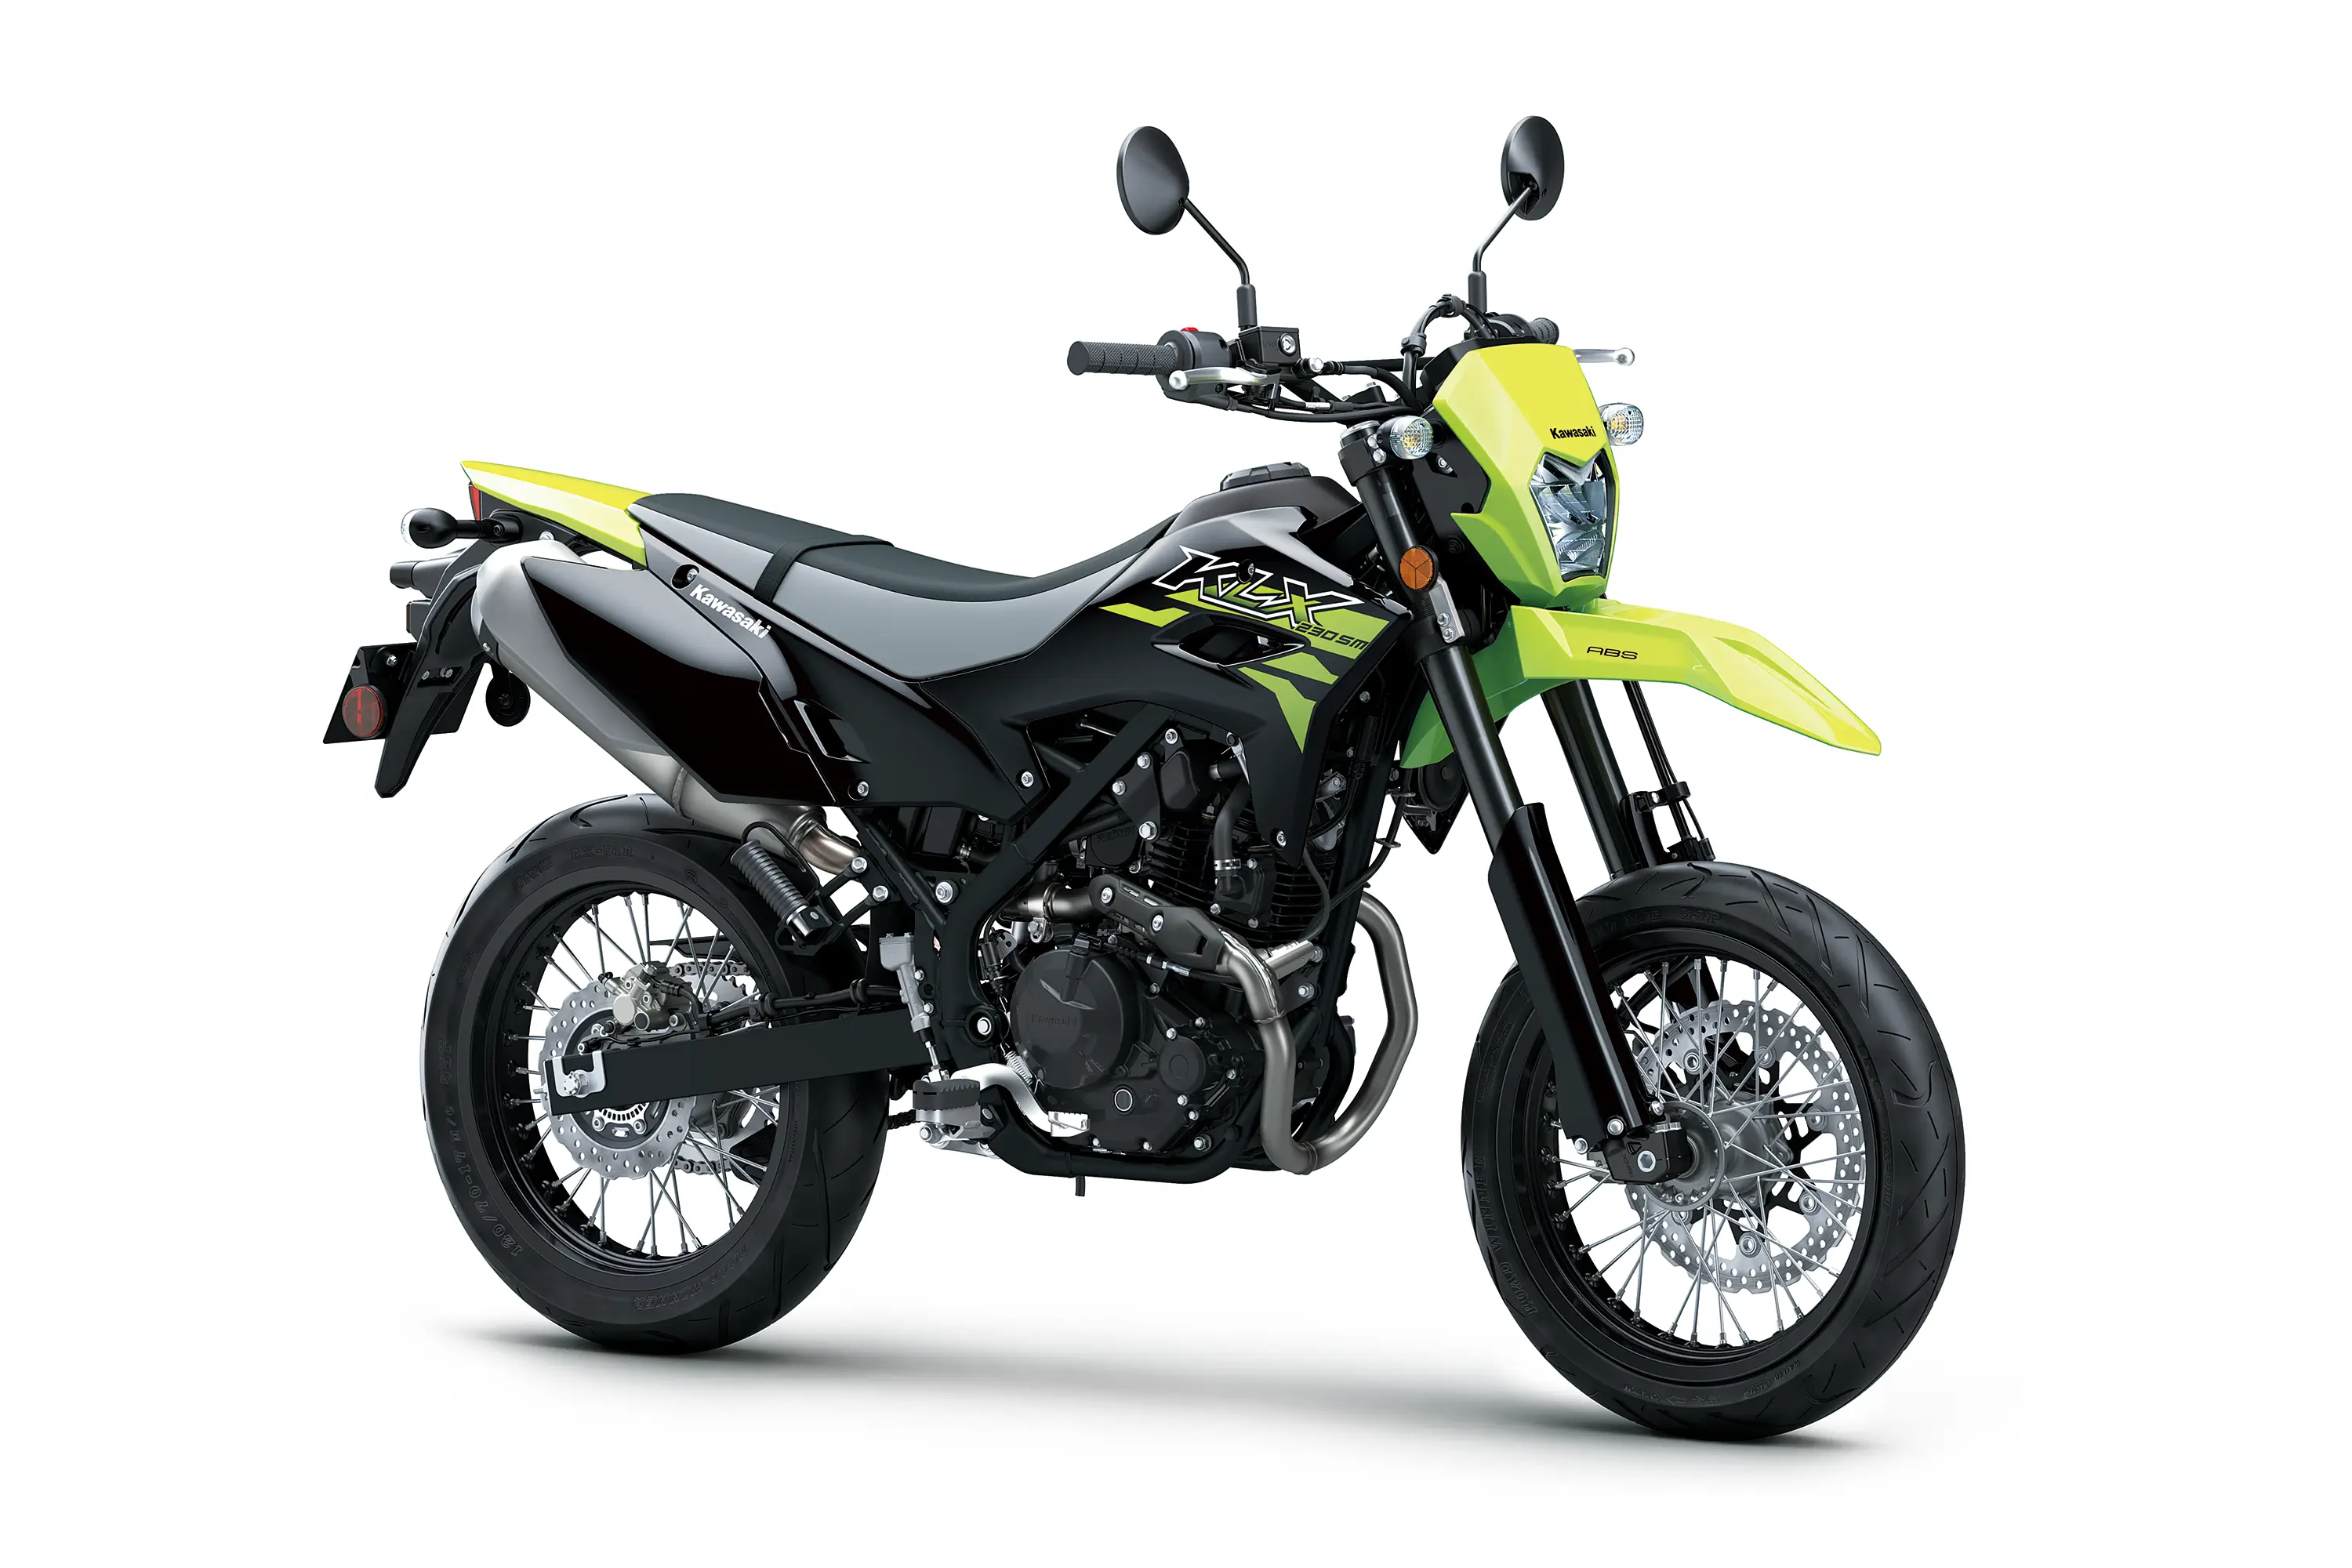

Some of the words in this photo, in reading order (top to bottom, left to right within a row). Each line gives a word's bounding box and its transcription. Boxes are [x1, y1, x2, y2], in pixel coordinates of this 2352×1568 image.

[1549, 426, 1597, 440] Kawasaki
[689, 583, 771, 639] Kawasaki
[1152, 545, 1364, 629] KLX
[1586, 646, 1639, 660] ABS
[453, 1150, 524, 1257] 120/70-17
